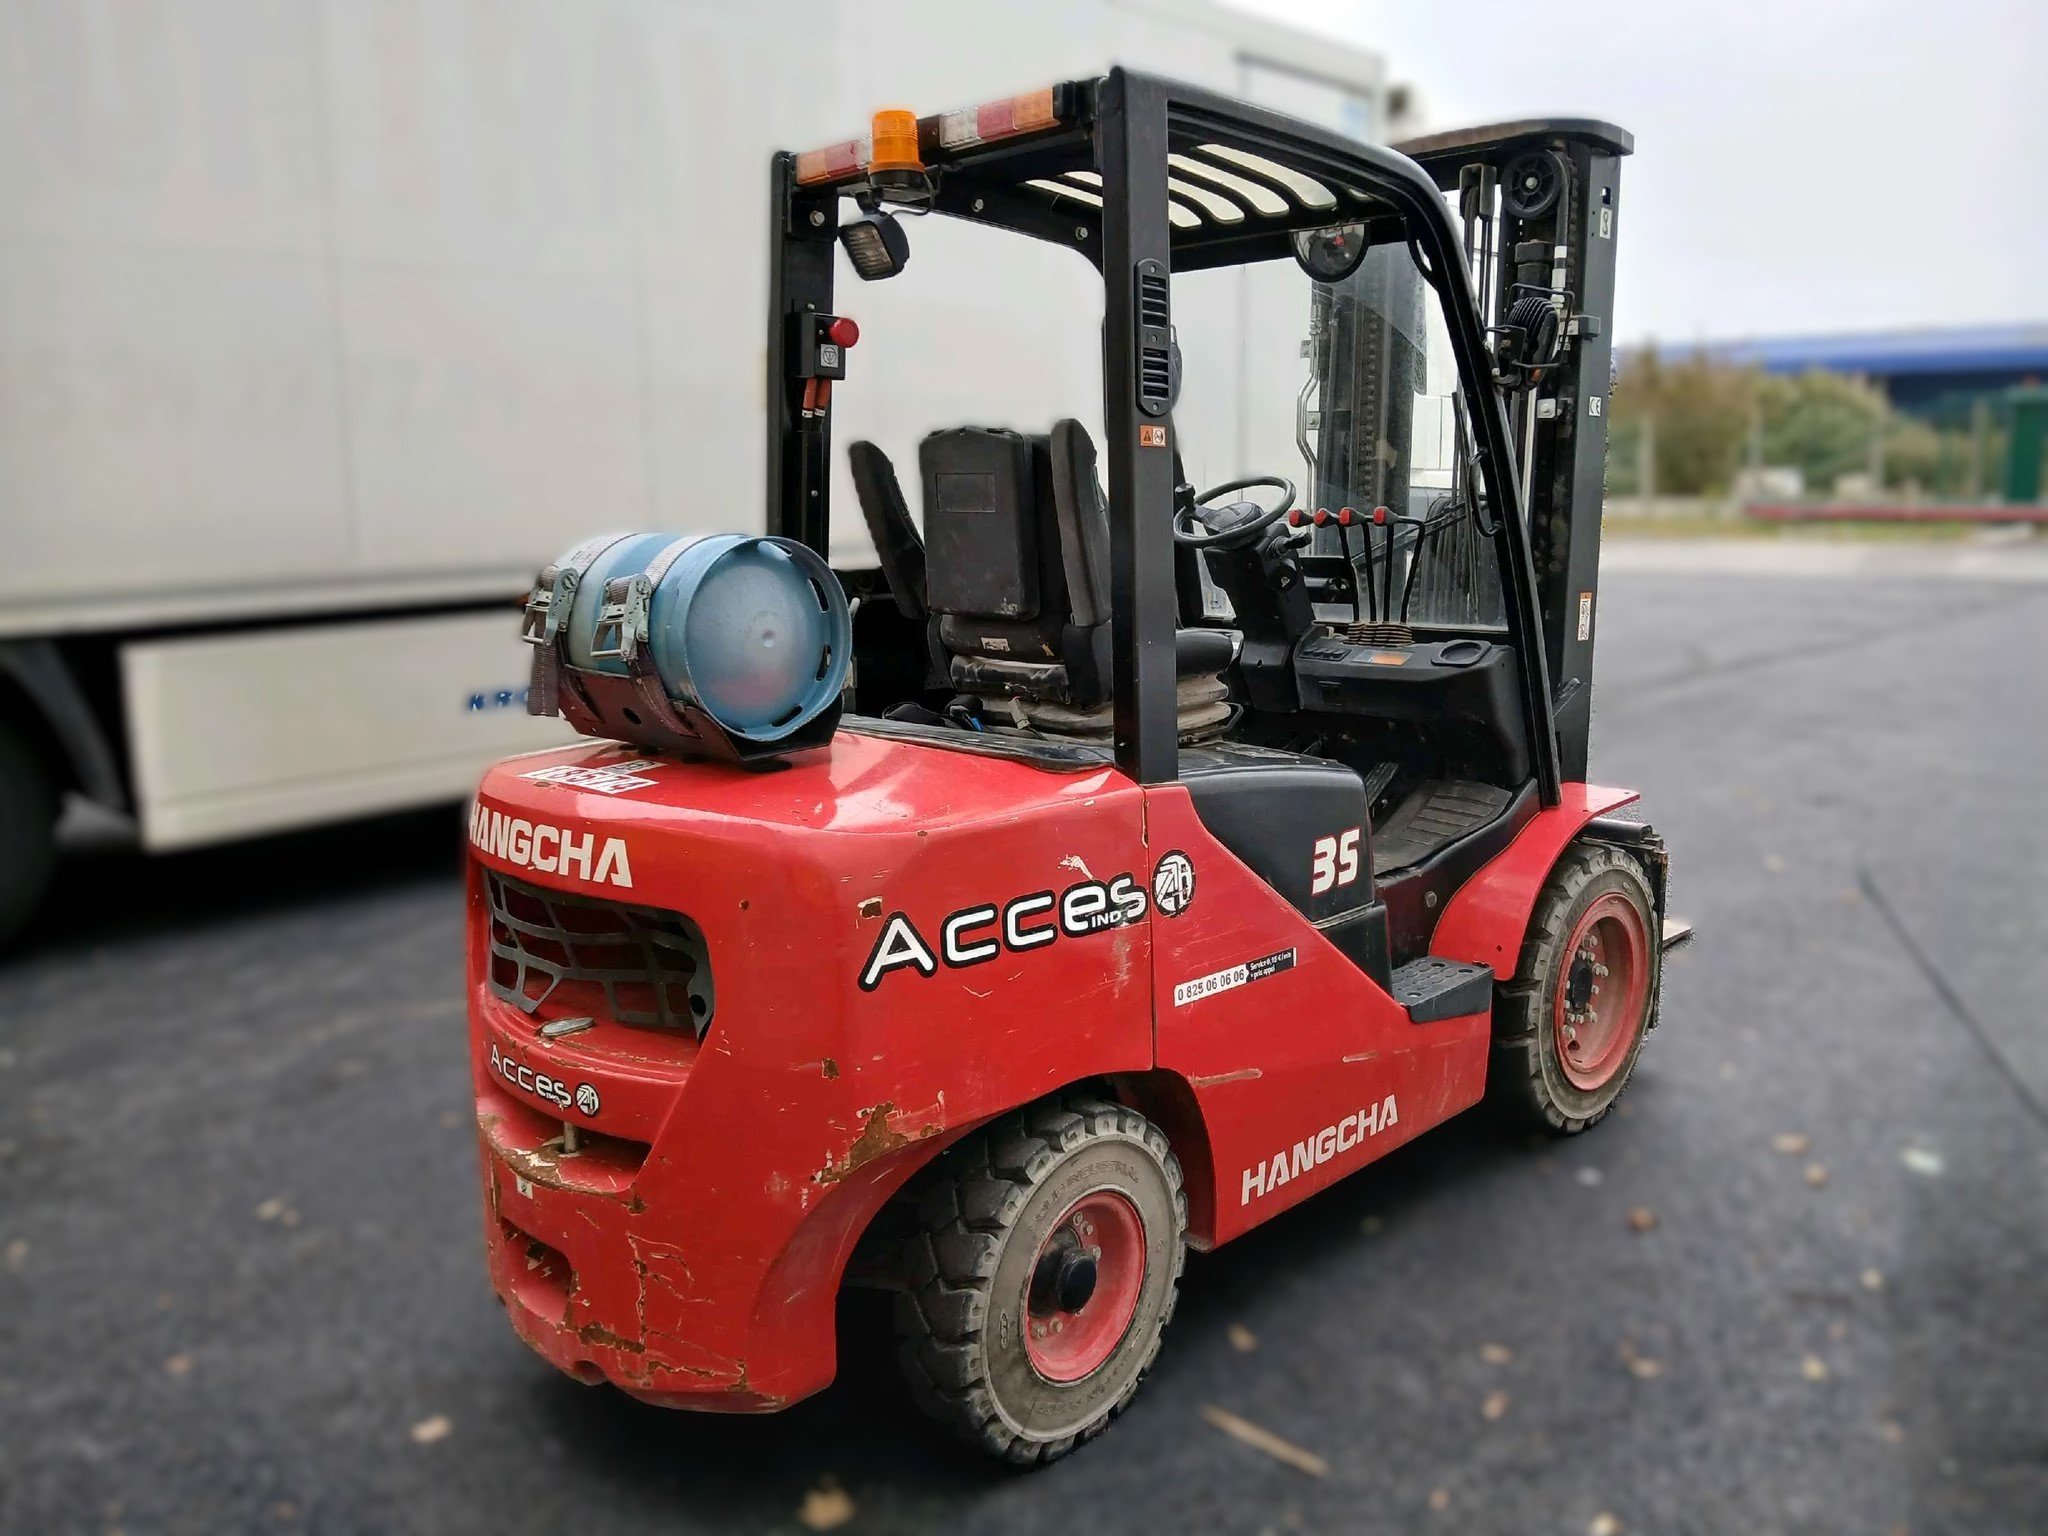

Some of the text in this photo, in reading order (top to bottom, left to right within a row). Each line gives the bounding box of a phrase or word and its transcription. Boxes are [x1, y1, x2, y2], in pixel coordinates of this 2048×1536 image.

[469, 802, 633, 888] HANGCHA
[1312, 827, 1360, 896] 35
[1177, 968, 1245, 1001] 0 825 06 06 06
[1241, 1094, 1399, 1207] HANGCHA
